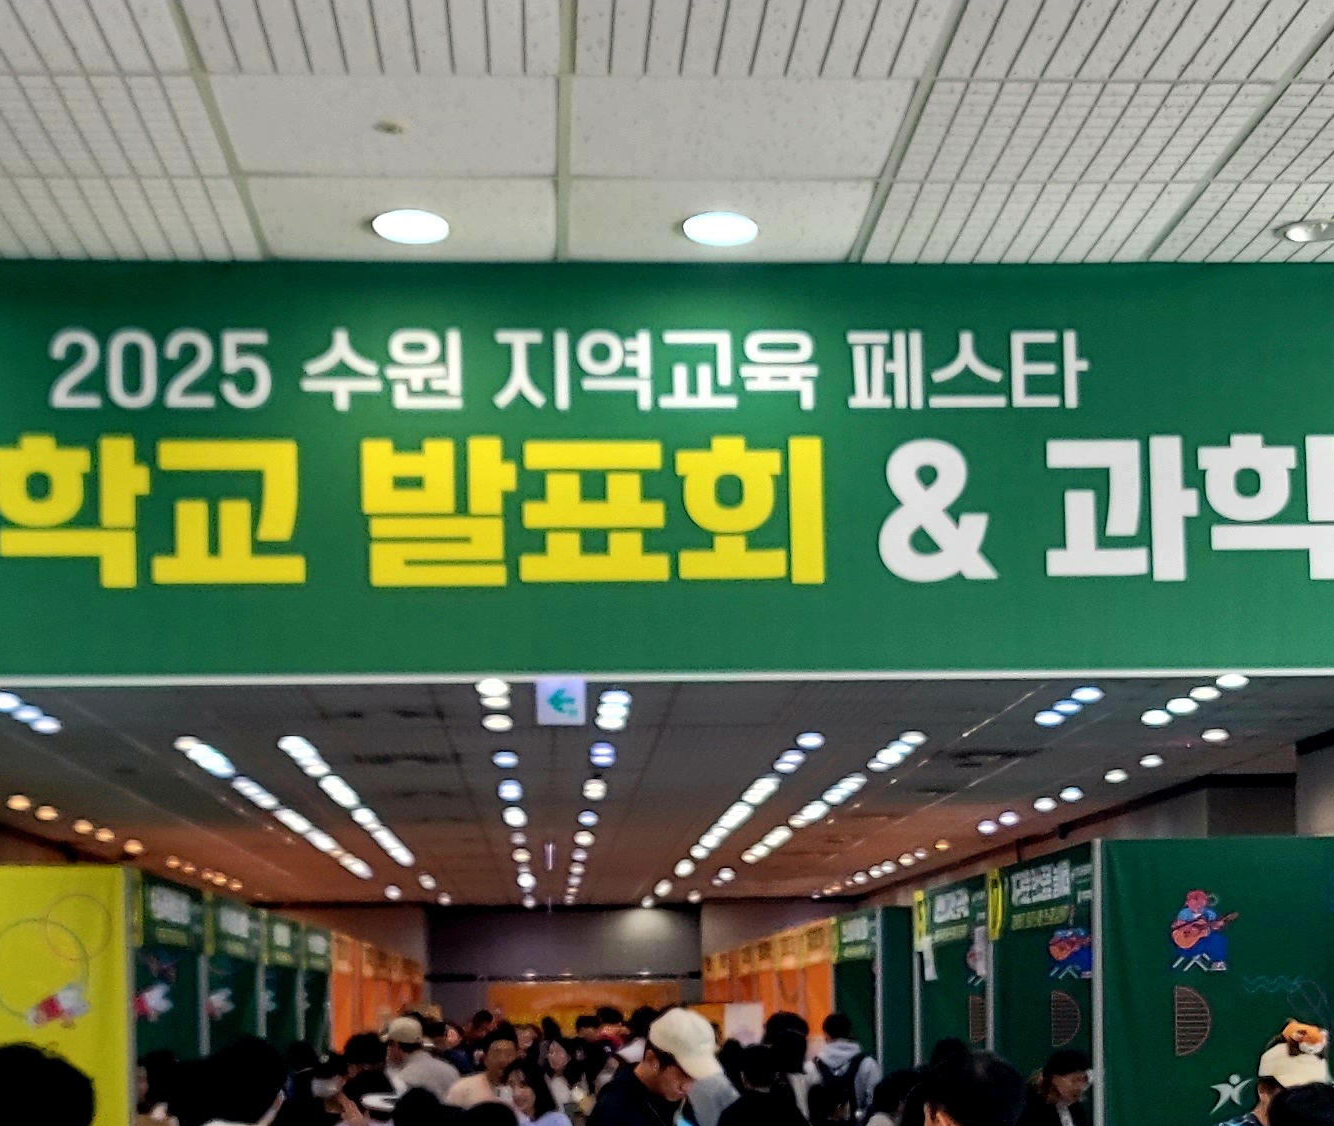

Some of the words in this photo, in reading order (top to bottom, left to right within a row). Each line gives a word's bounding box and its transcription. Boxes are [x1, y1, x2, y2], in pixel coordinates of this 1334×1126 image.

[51, 331, 272, 409] 2025
[301, 329, 464, 412] 수원
[493, 329, 819, 411] 지역교육
[847, 330, 1089, 410] 페스타
[360, 435, 827, 588] 발표회
[877, 438, 998, 583] &
